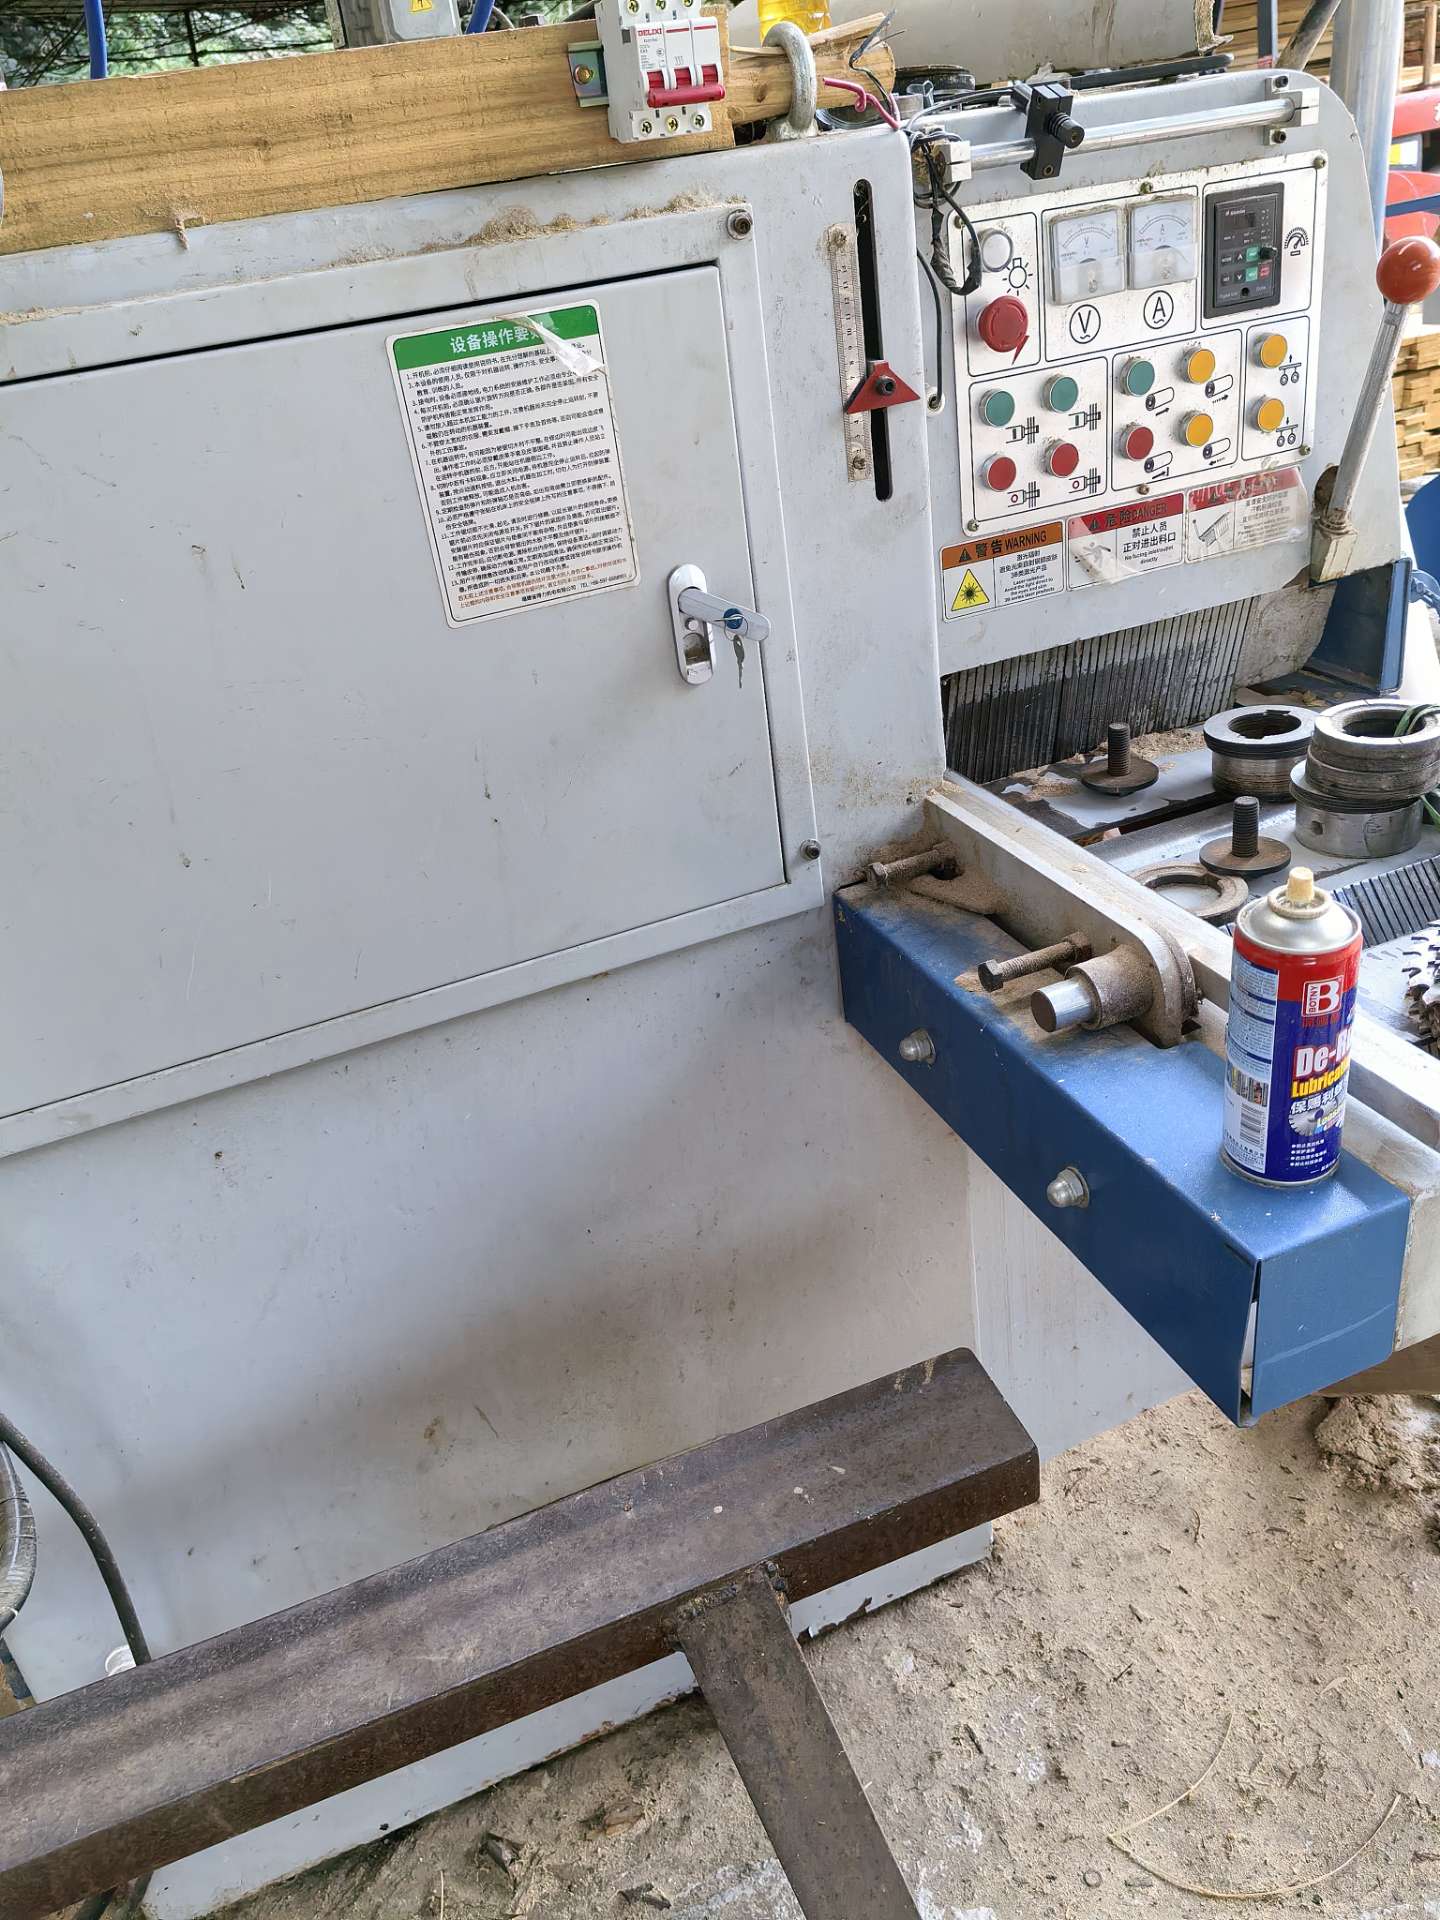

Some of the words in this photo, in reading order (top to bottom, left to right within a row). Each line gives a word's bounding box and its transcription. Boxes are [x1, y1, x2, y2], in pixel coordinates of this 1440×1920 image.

[1152, 296, 1166, 319] A
[1078, 310, 1091, 334] V
[1106, 510, 1130, 527] 危险
[1132, 521, 1167, 538] 禁止人员
[976, 539, 1003, 558] 警告
[1005, 530, 1047, 551] WARNING
[1123, 532, 1176, 553] 正对进出料口
[1309, 985, 1318, 1013] BOTNY
[1318, 980, 1340, 1013] B
